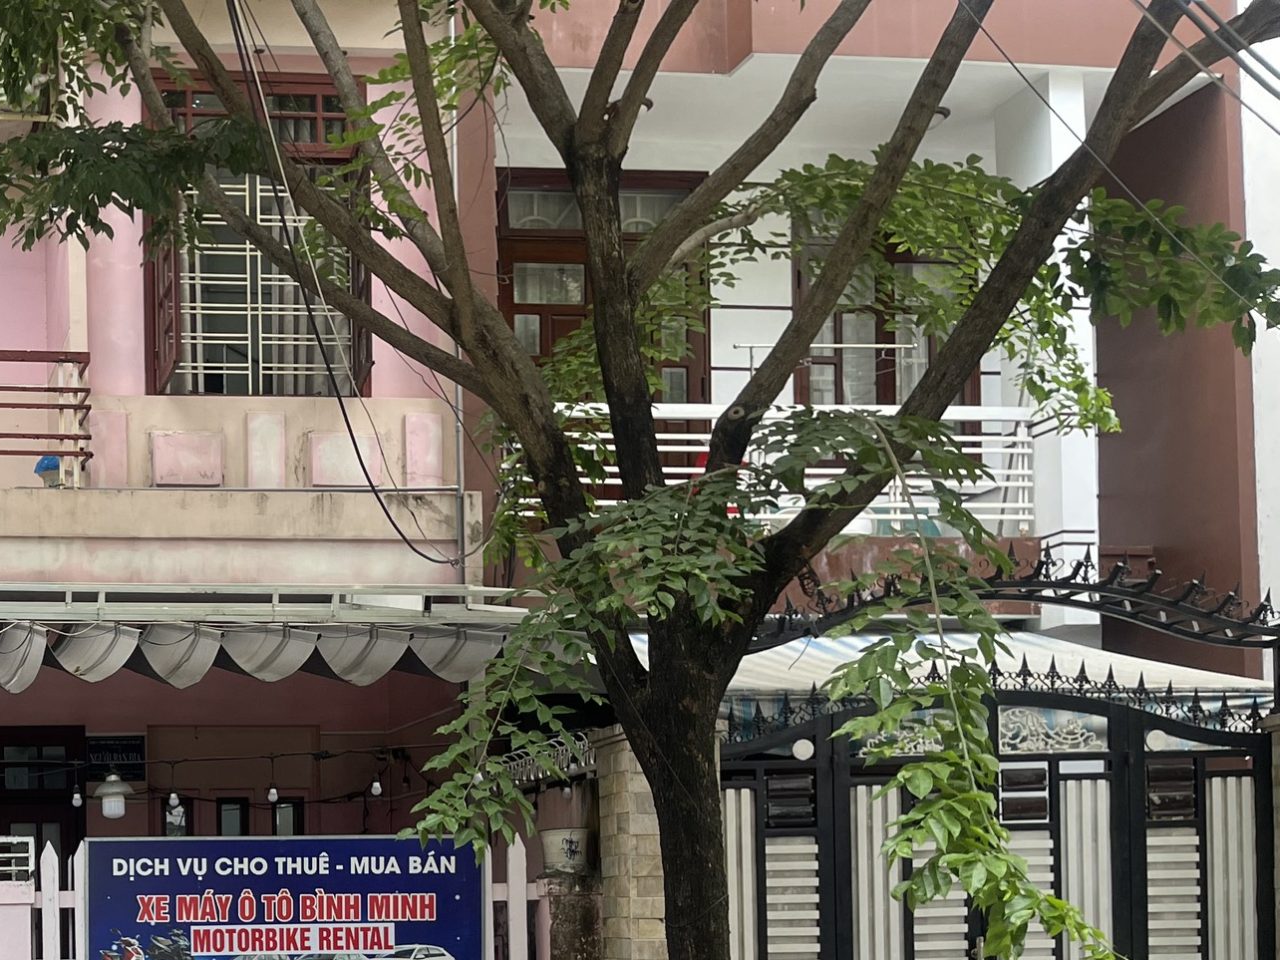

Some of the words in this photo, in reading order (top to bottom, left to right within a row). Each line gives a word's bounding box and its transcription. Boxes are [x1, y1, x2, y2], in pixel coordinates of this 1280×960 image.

[112, 857, 169, 881] DỊCH
[177, 857, 208, 881] VỤ
[214, 857, 268, 876] CHO
[274, 851, 329, 875] THUÊ
[350, 856, 401, 875] MUA
[408, 850, 456, 874] BÁN
[137, 894, 170, 923] XE
[176, 888, 233, 923] MÁY
[238, 888, 257, 922] Ô
[261, 888, 294, 922] TÔ
[300, 888, 361, 922] BÌNH
[368, 893, 437, 921] MINH
[192, 926, 312, 952] MOTORBIKE
[319, 926, 394, 951] RENTAL
